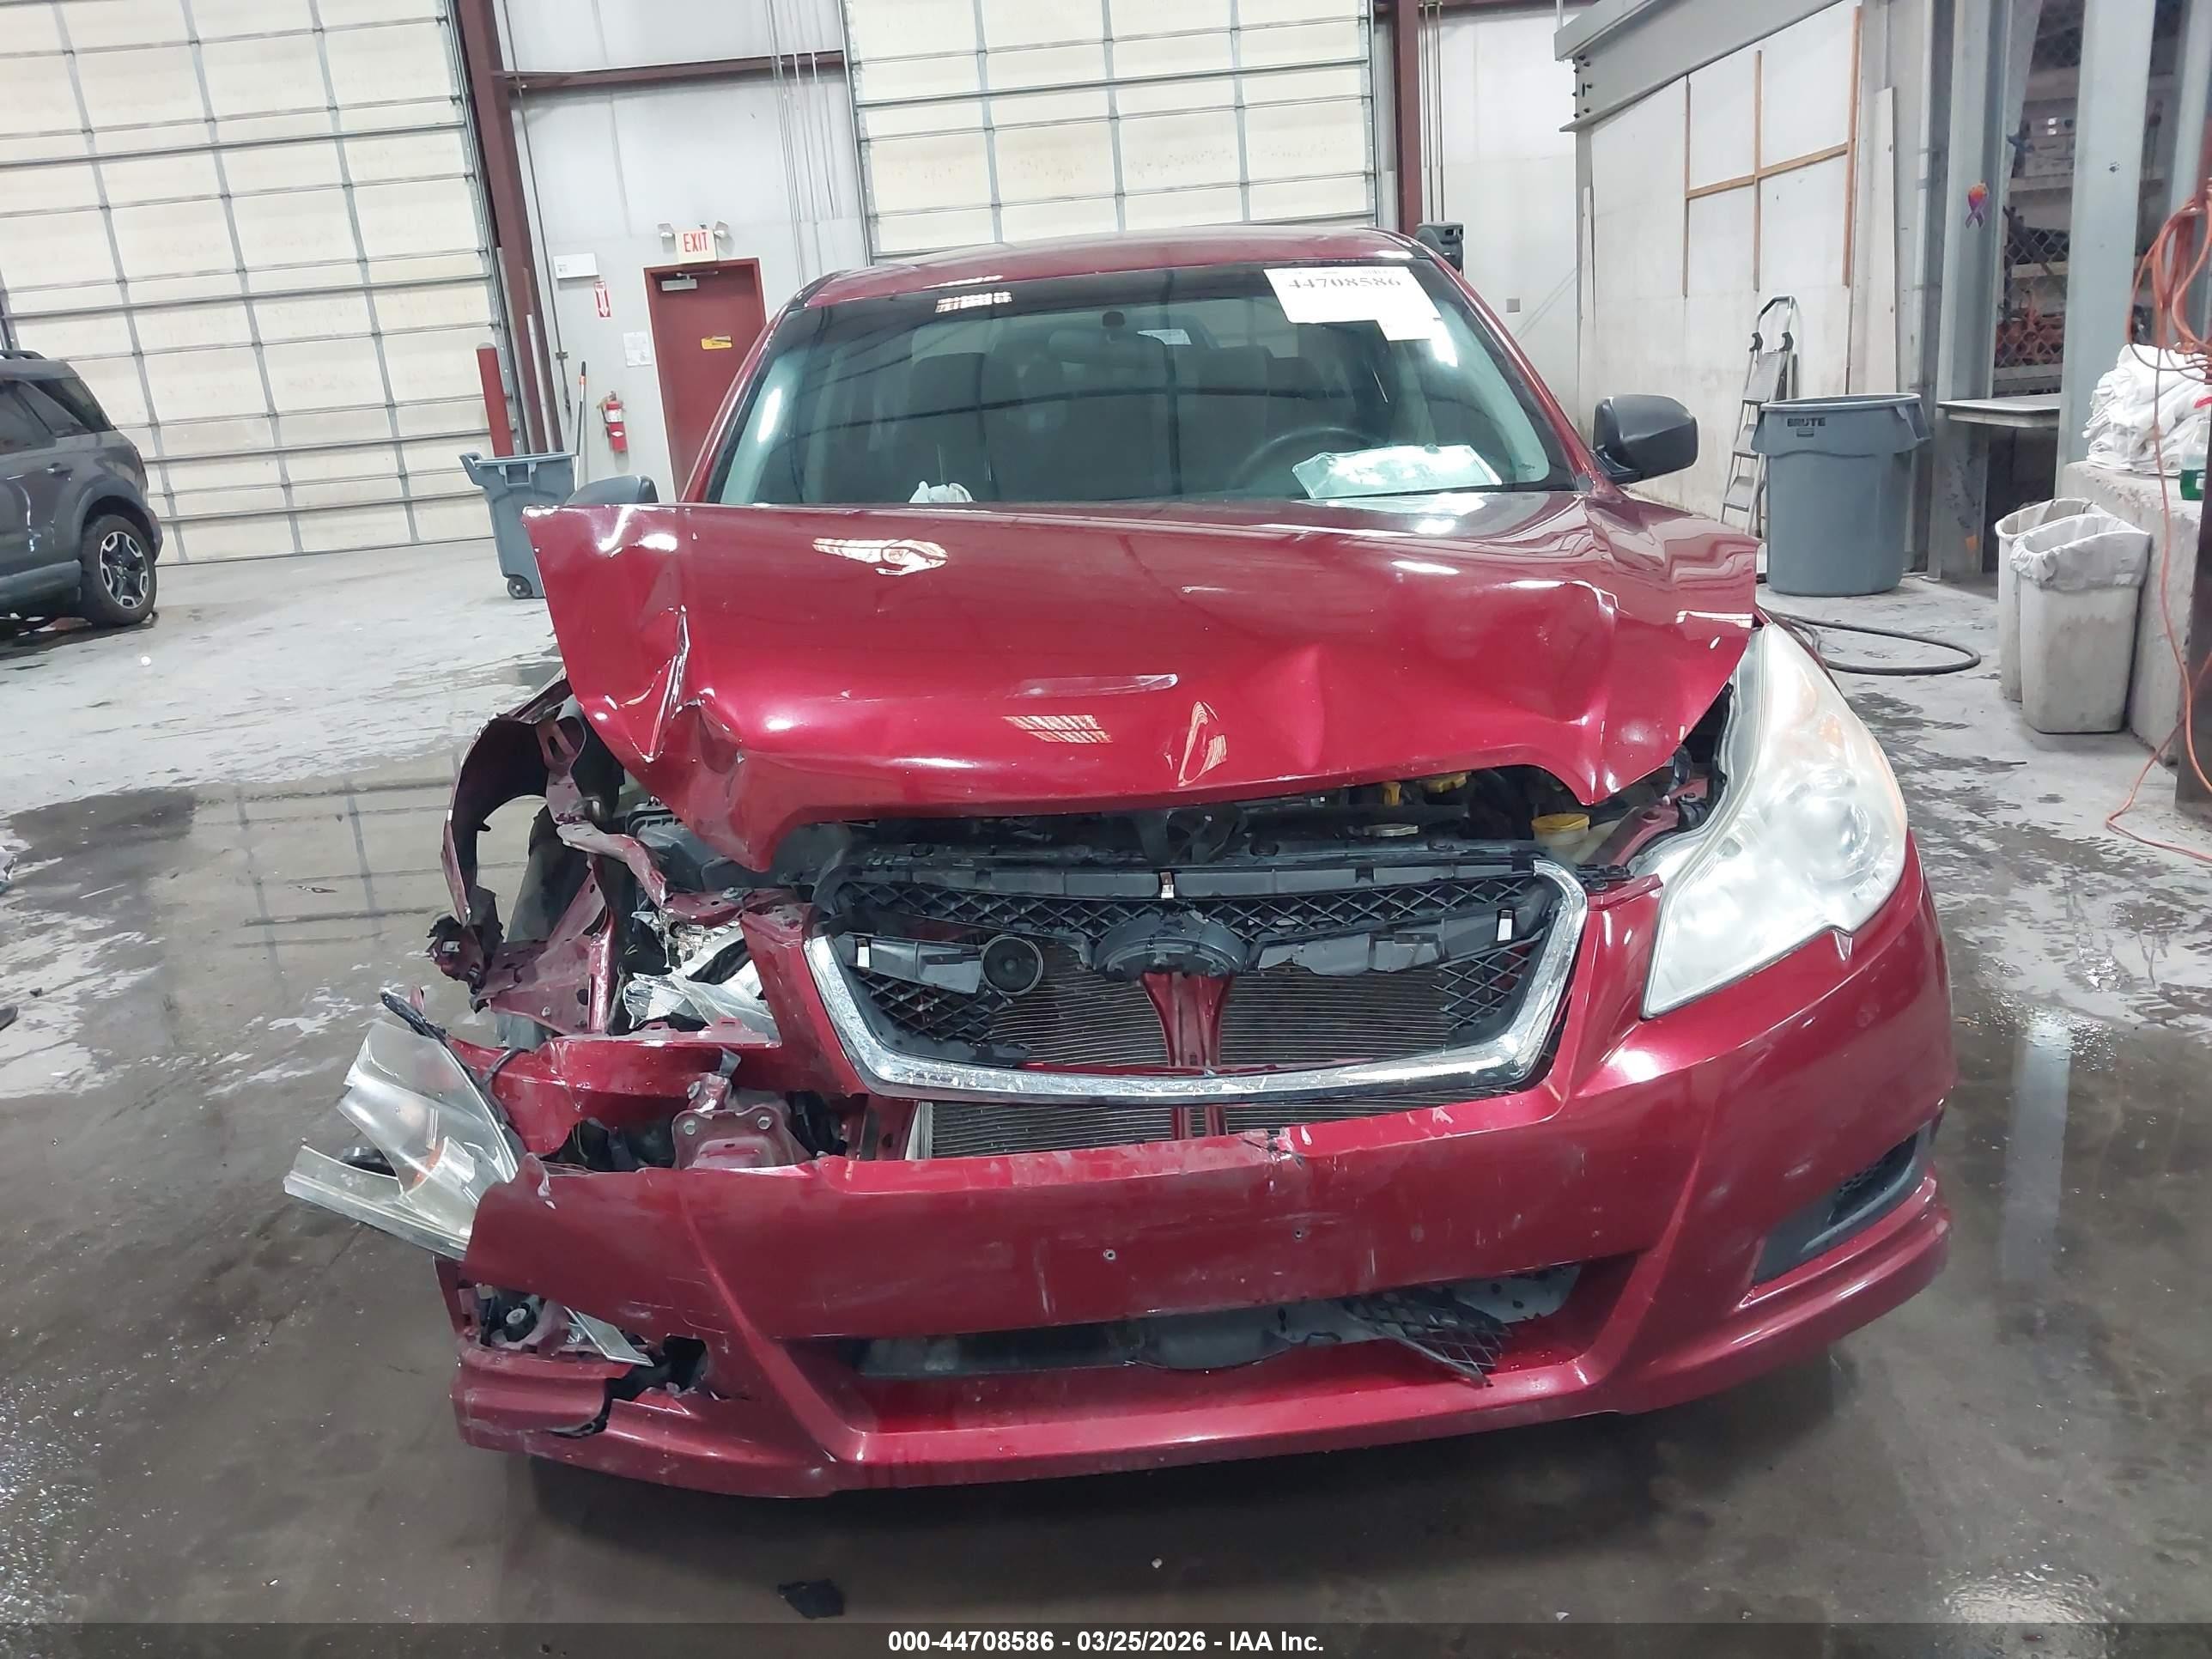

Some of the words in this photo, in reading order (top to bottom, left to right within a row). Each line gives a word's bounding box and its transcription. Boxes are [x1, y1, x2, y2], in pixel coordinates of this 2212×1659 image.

[683, 231, 708, 252] EXIT
[1288, 277, 1401, 289] 44708586
[1787, 417, 1826, 427] BRUTE
